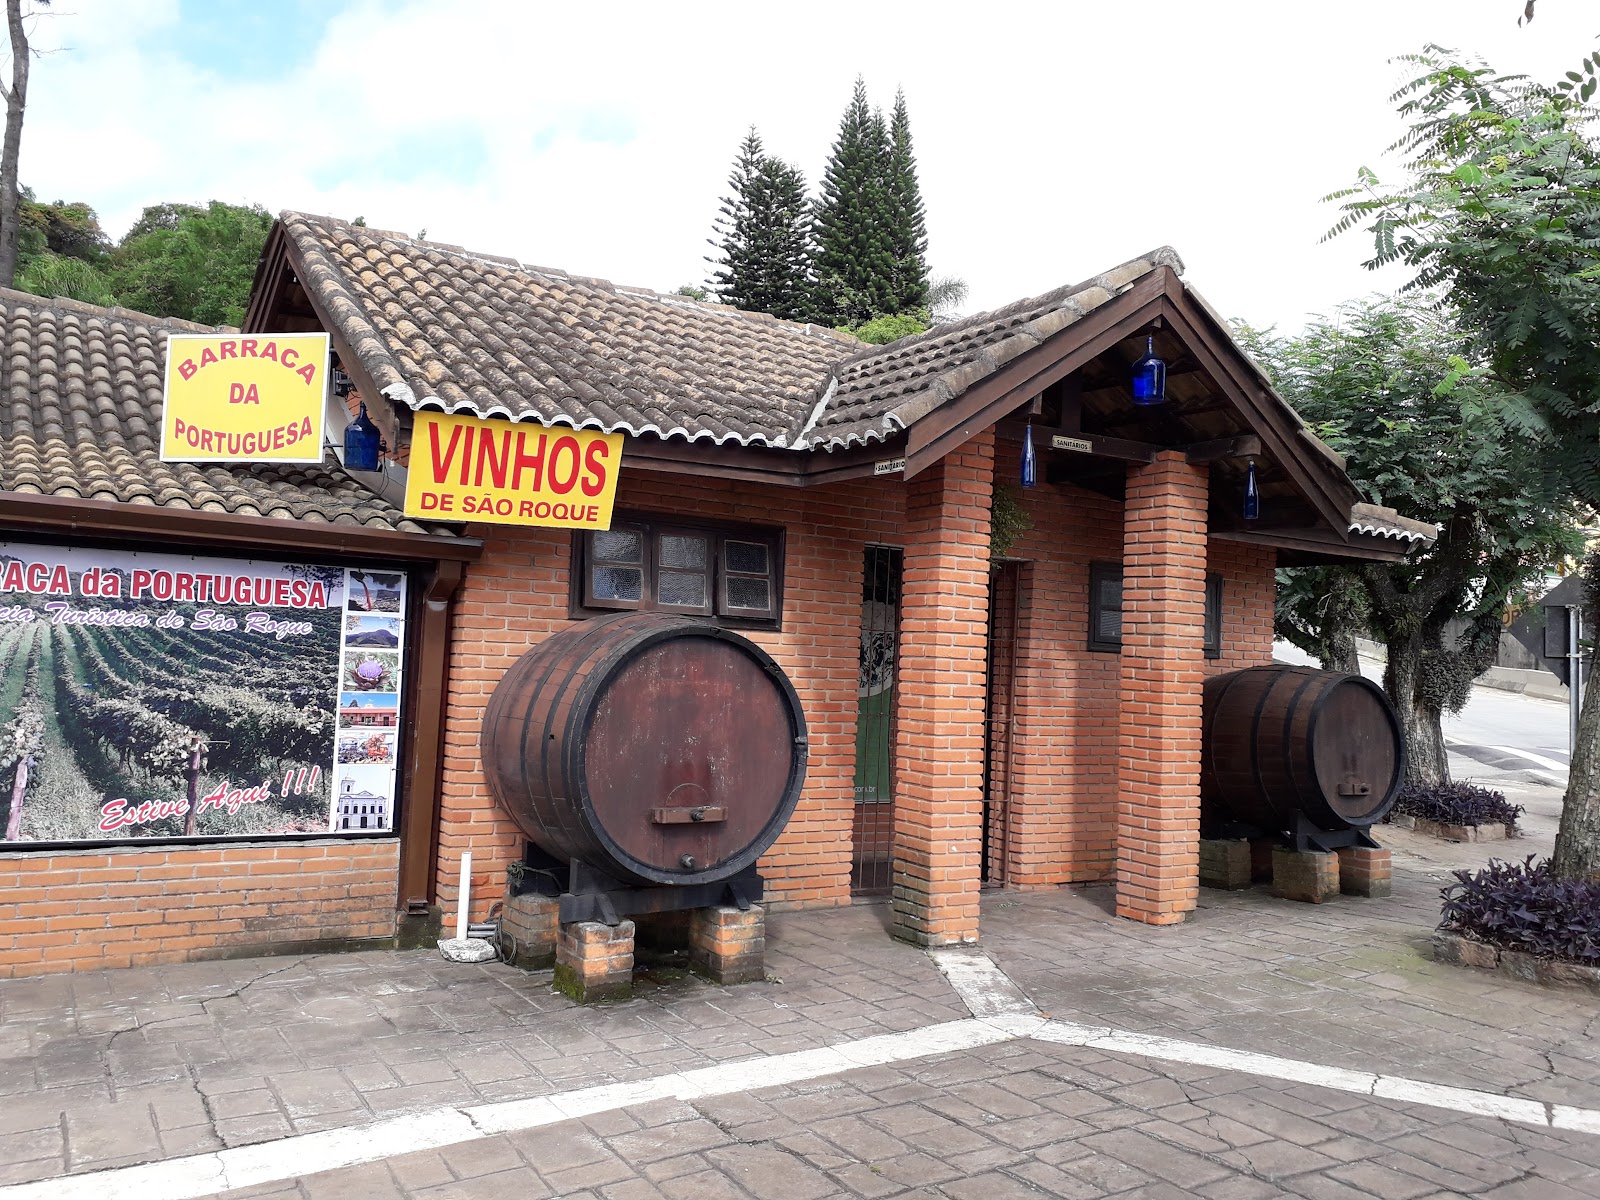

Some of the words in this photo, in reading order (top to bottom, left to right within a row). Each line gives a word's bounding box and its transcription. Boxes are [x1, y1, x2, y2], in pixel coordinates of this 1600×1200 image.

[177, 338, 317, 386] BARRACA
[229, 382, 260, 405] DA
[174, 415, 313, 455] PORTUGUESA
[428, 421, 610, 497] VINHOS
[420, 492, 454, 513] DE
[462, 492, 513, 516] SÃO
[518, 499, 599, 522] ROQUE
[81, 567, 120, 596] da
[131, 569, 326, 608] PORTUGUESA
[45, 602, 150, 627] Turística
[156, 610, 184, 629] de
[190, 609, 237, 631] São
[245, 612, 312, 640] Roque
[99, 798, 190, 831] Estive
[197, 780, 270, 815] Aqui
[281, 766, 320, 797] !!!
